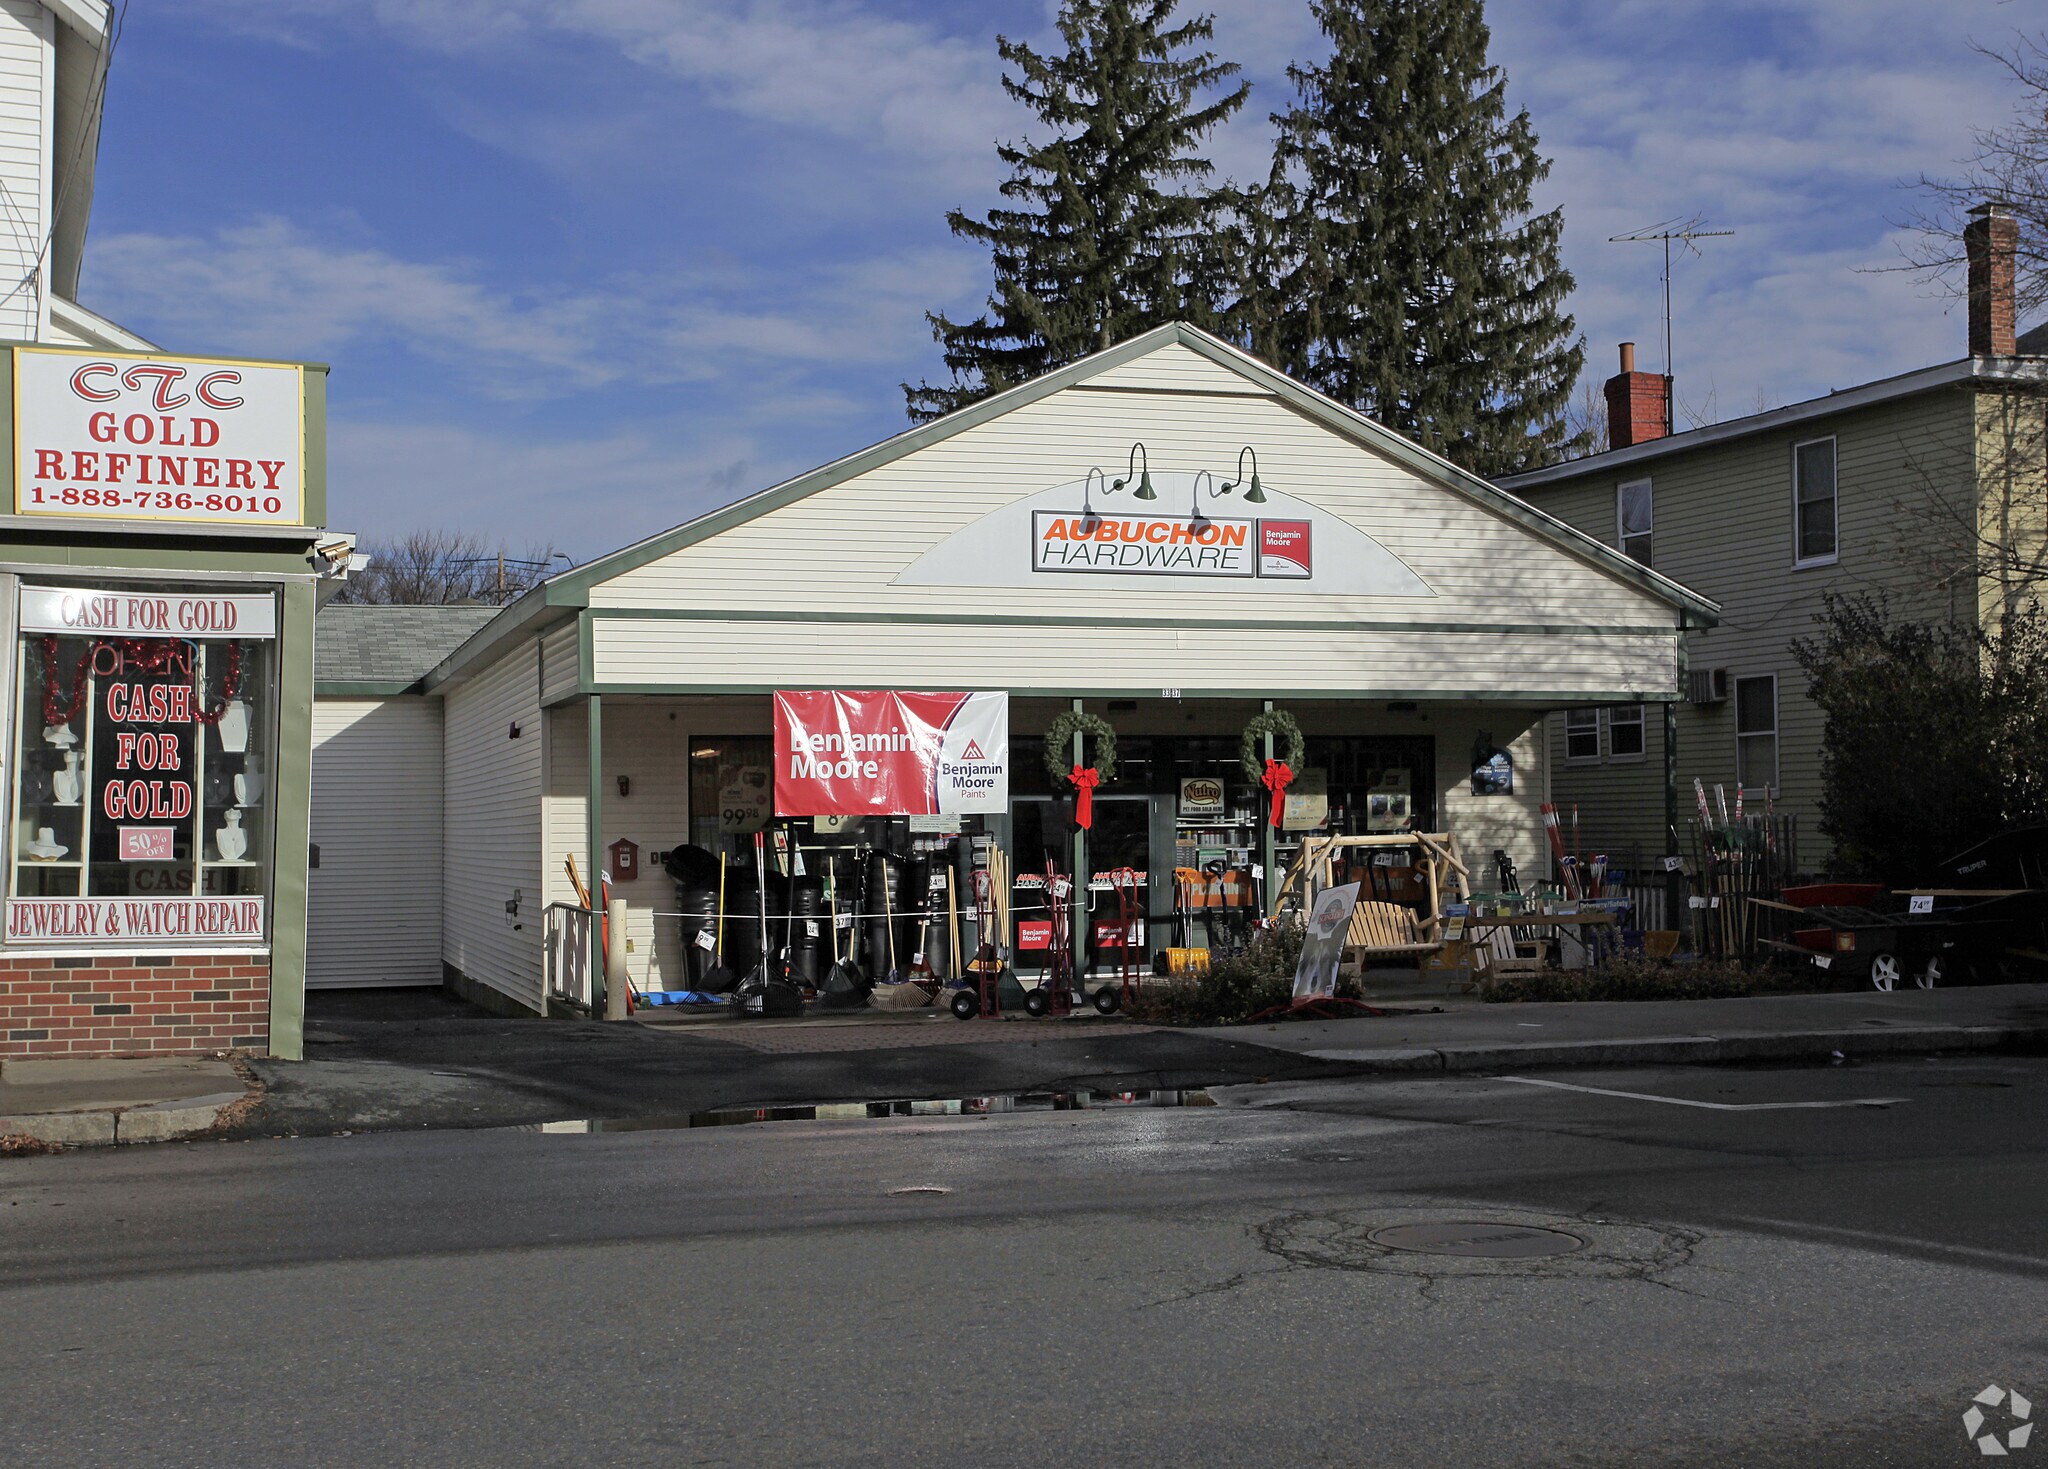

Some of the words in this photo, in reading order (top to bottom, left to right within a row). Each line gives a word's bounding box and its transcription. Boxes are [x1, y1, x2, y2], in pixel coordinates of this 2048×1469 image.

[70, 362, 244, 412] CTC
[88, 411, 220, 448] GOLD
[34, 449, 286, 490] REFINERY
[31, 487, 282, 514] 1-888-736-8010
[1042, 518, 1247, 546] AUBUCHON
[1266, 530, 1301, 539] Benjamin
[1266, 538, 1291, 546] Moore
[1042, 542, 1243, 570] HARDWARE
[61, 594, 119, 628] CASH
[127, 599, 169, 631] FOR
[178, 600, 238, 631] GOLD
[107, 682, 192, 723] CASH
[116, 733, 181, 771] FOR
[790, 727, 917, 758] Benjamin
[790, 755, 879, 779] Moore
[942, 762, 1003, 778] Benjamin
[952, 776, 994, 788] Moore
[961, 790, 986, 798] Paints
[1184, 782, 1220, 802] Nutro
[104, 780, 192, 820] GOLD
[146, 845, 165, 857] OFF
[135, 869, 216, 891] CASH
[1956, 860, 1987, 876] TRUPER
[9, 903, 101, 936] JEWELRY
[104, 903, 121, 935] &
[124, 902, 190, 935] WATCH
[195, 901, 260, 934] REPAIR
[1022, 929, 1050, 937] Benjamin
